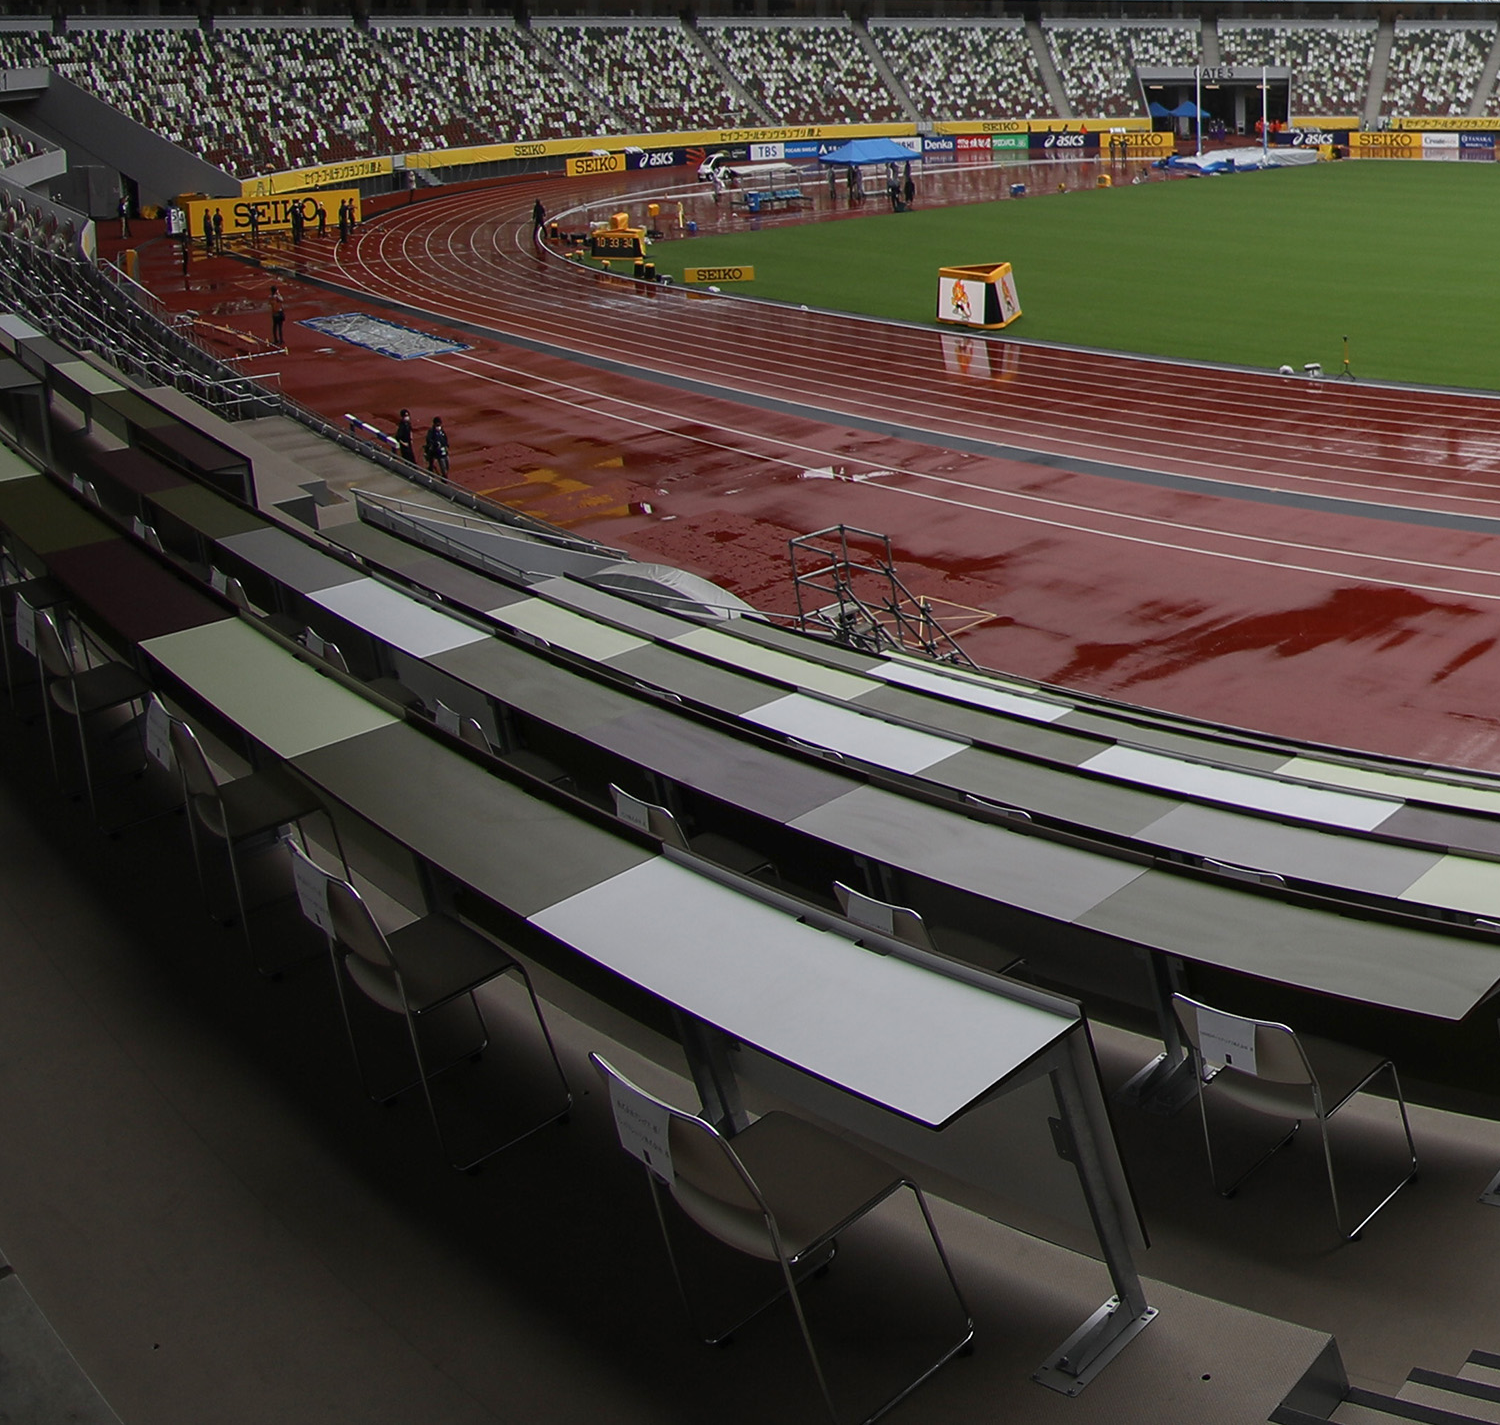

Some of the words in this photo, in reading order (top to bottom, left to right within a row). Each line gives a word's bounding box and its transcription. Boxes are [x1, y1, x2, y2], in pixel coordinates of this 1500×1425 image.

[982, 121, 1019, 132] SEIKO
[924, 138, 953, 149] Denka
[1360, 134, 1412, 146] SEIKO
[514, 144, 546, 156] SEIKO
[758, 146, 777, 157] TBS
[575, 156, 618, 174] SEIKO
[697, 268, 743, 281] SEIKO
